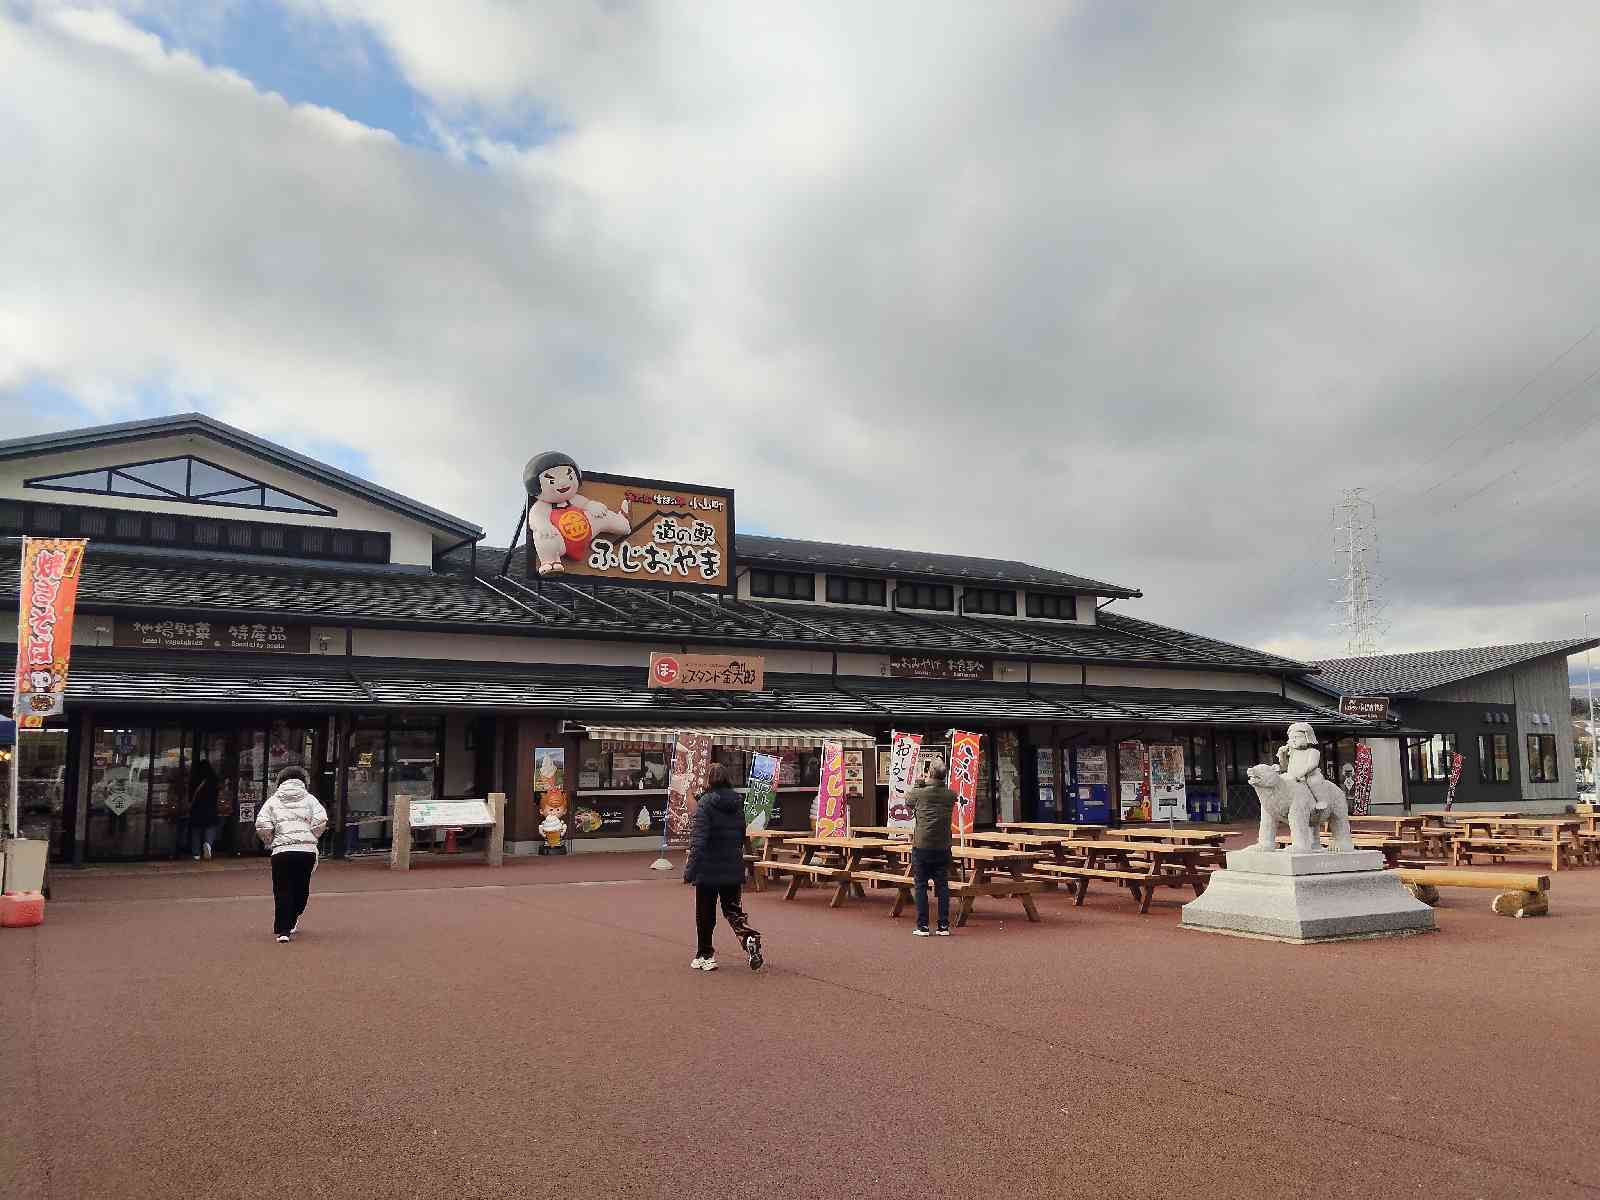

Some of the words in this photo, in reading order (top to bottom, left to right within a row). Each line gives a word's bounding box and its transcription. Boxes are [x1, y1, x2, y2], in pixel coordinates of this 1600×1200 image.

[688, 496, 724, 512] 小山町
[654, 518, 715, 543] 道の駅
[591, 541, 719, 578] ふじおやま
[228, 623, 287, 642] 特産品
